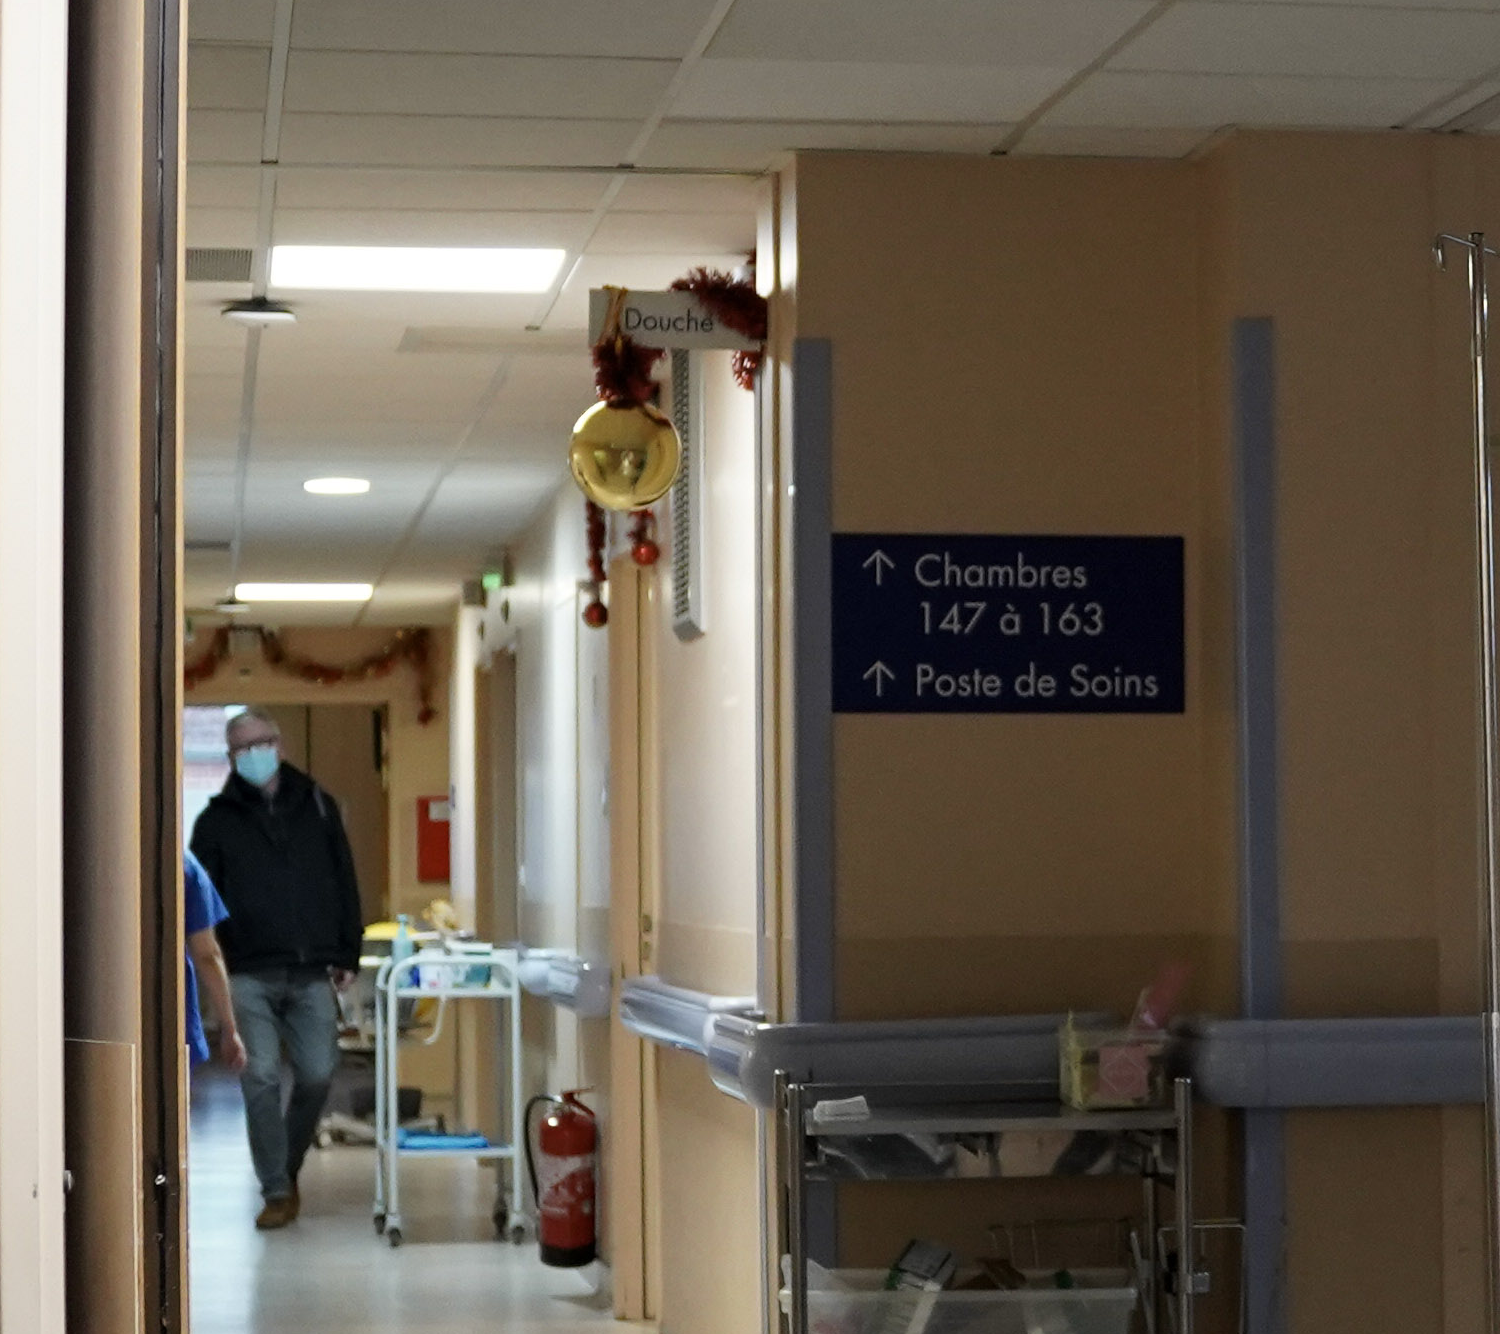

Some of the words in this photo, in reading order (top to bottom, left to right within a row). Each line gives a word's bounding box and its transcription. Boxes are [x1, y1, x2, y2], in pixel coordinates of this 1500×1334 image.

[624, 307, 715, 333] Douche
[914, 551, 1088, 588] Chambres
[920, 601, 987, 635] 147
[999, 602, 1021, 635] à
[1040, 602, 1104, 636] 163
[916, 663, 1002, 697] Poste
[1014, 661, 1057, 698] de
[1070, 662, 1160, 698] Soins
